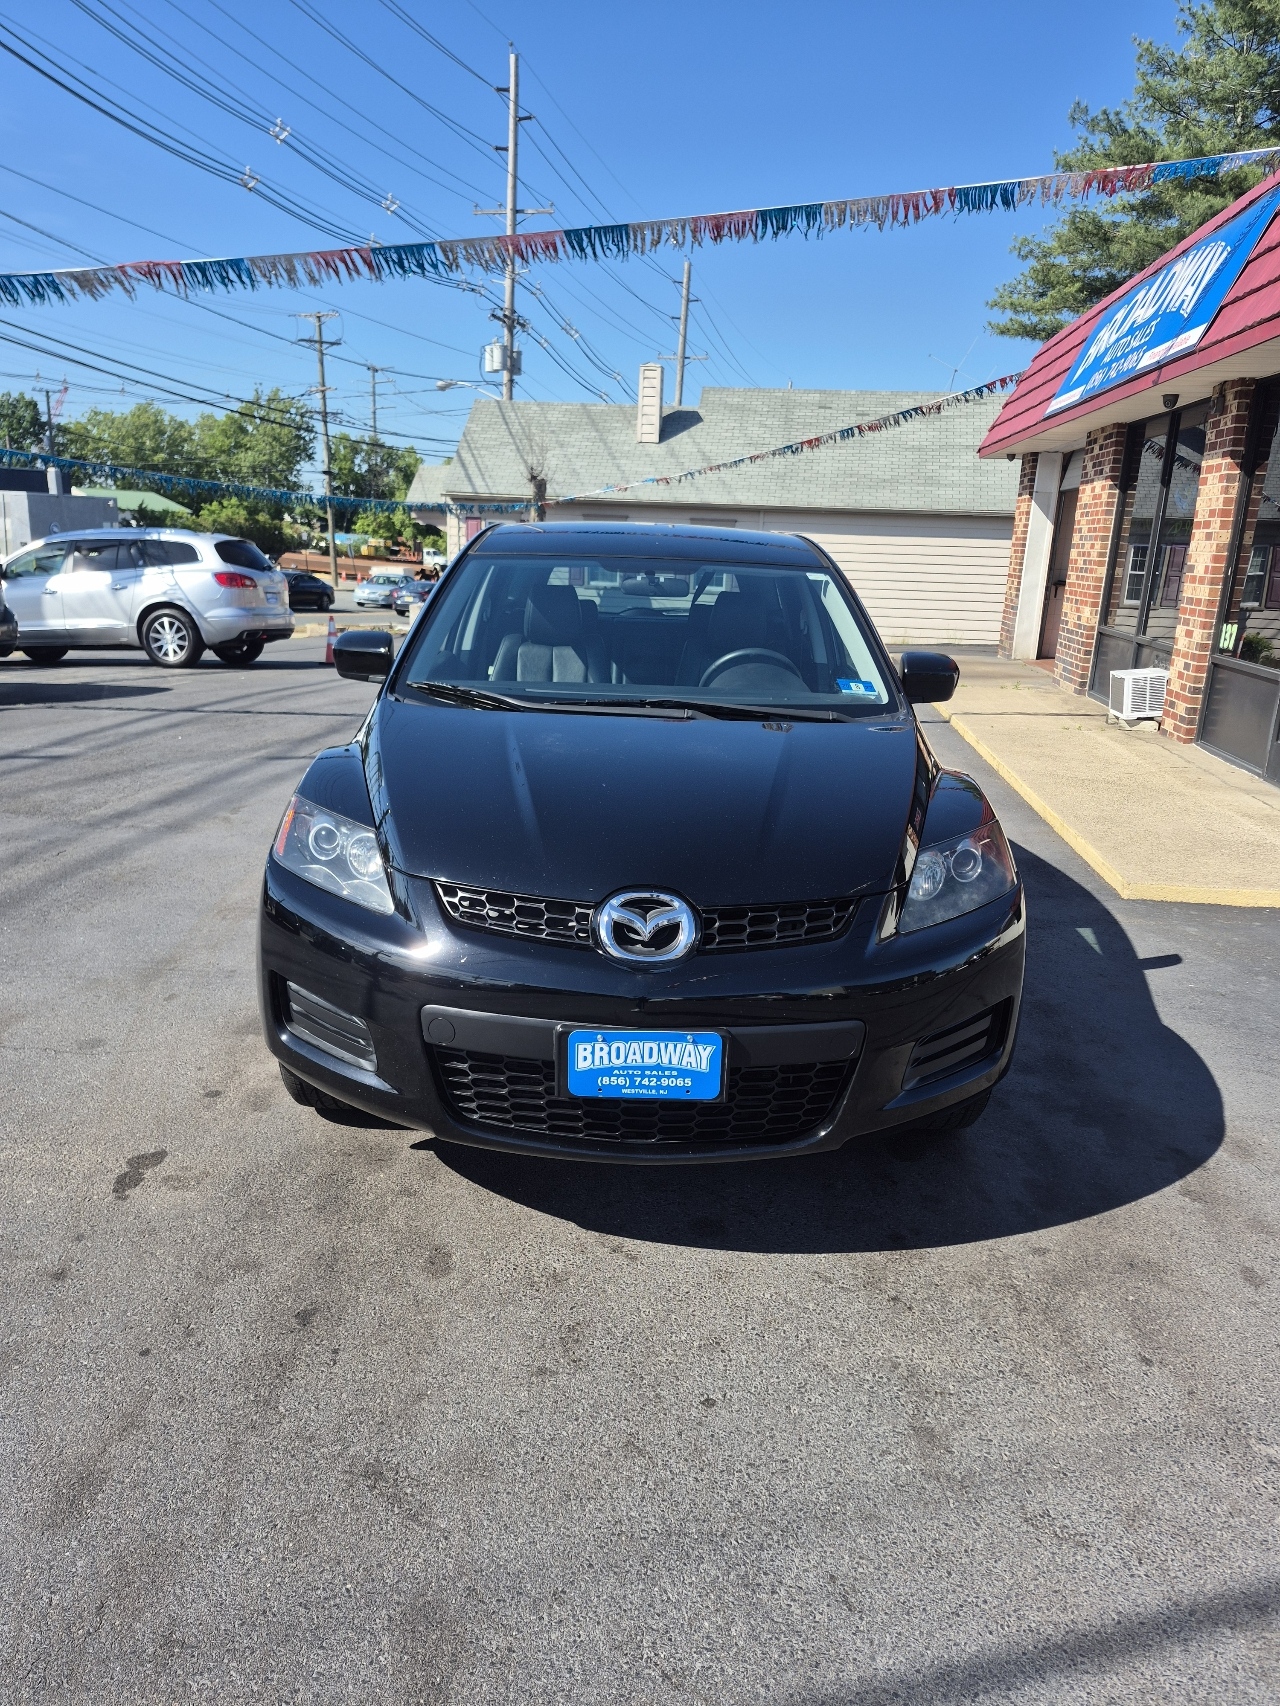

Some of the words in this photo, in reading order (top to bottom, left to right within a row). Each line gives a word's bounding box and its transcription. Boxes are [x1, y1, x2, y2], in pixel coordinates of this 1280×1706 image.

[1070, 240, 1231, 386] BROADWAY
[1100, 335, 1132, 366] AUTO
[1124, 317, 1161, 353] SALES
[575, 1041, 716, 1073] BROADWAY
[597, 1077, 630, 1088] (856)
[634, 1077, 692, 1087] 742-9065
